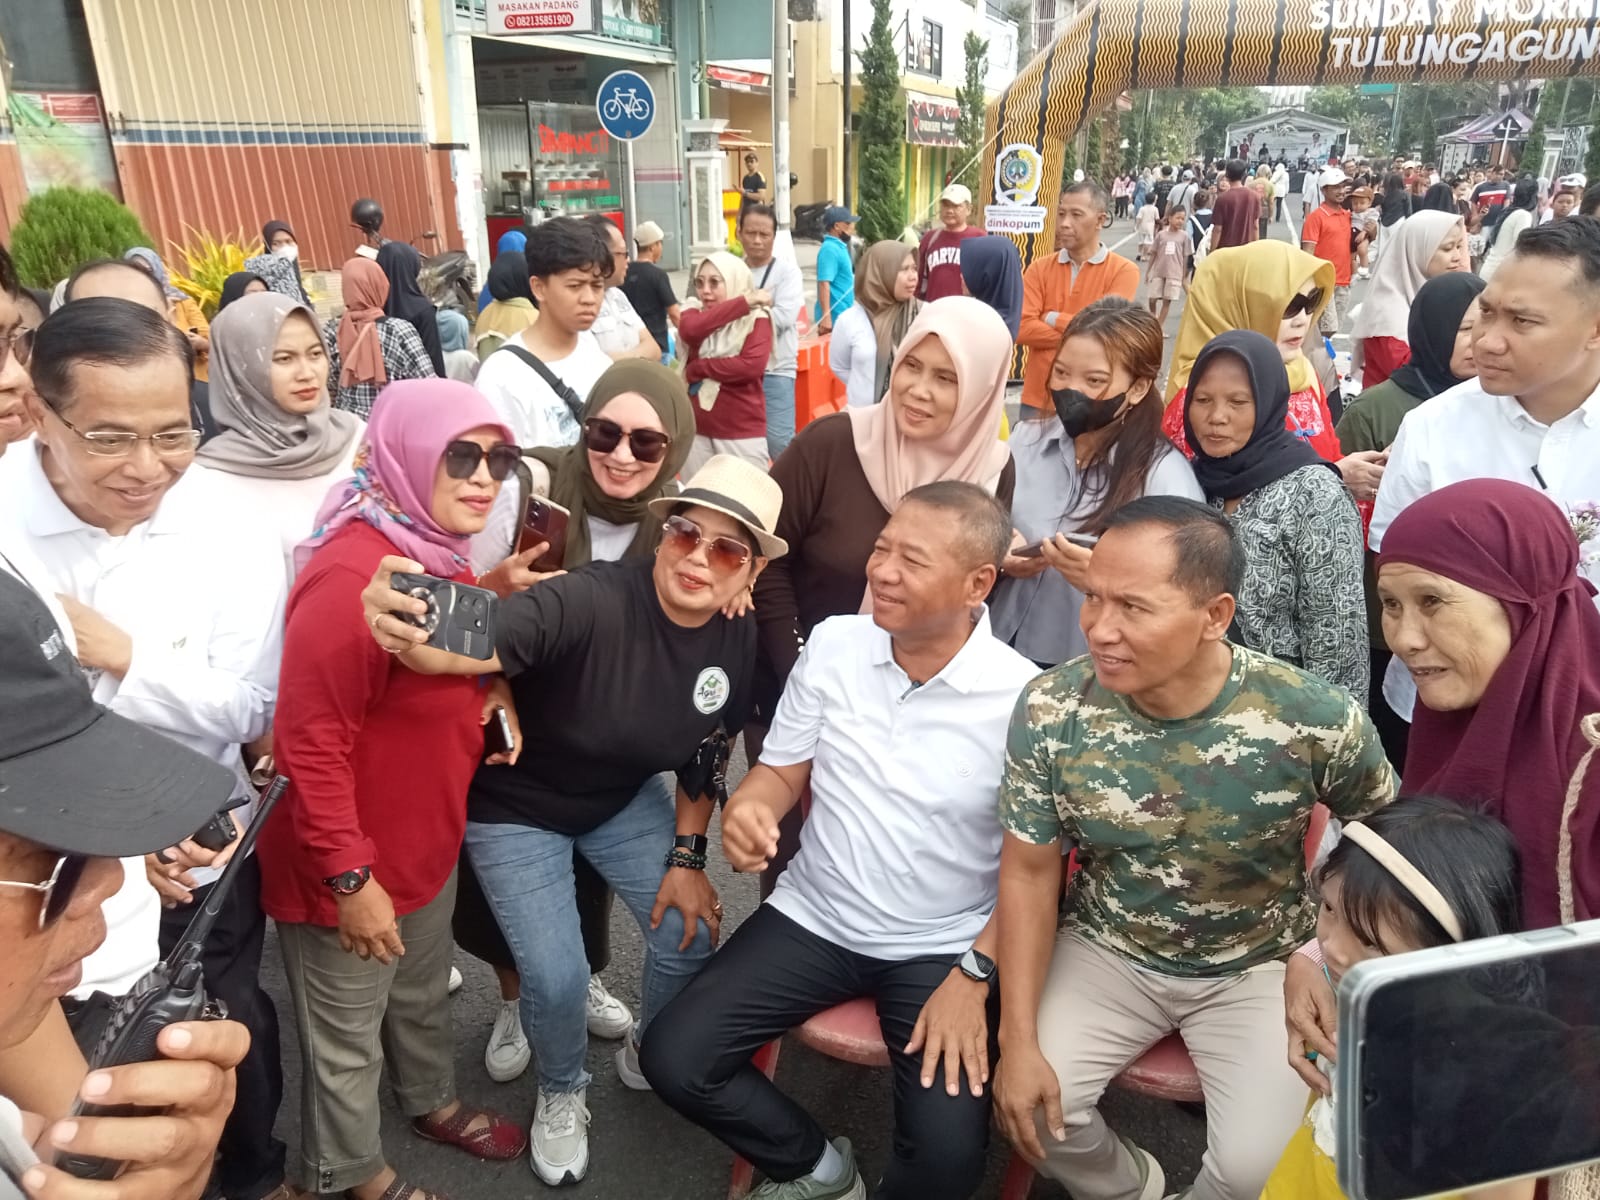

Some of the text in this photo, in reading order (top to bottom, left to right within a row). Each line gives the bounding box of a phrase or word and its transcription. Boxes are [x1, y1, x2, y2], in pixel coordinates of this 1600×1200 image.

[498, 0, 579, 12] MASAKAN PADANG
[1309, 0, 1600, 30] SUNDAY MORN
[1331, 28, 1600, 68] TULUNGAGUN
[987, 218, 1041, 230] dinkopum
